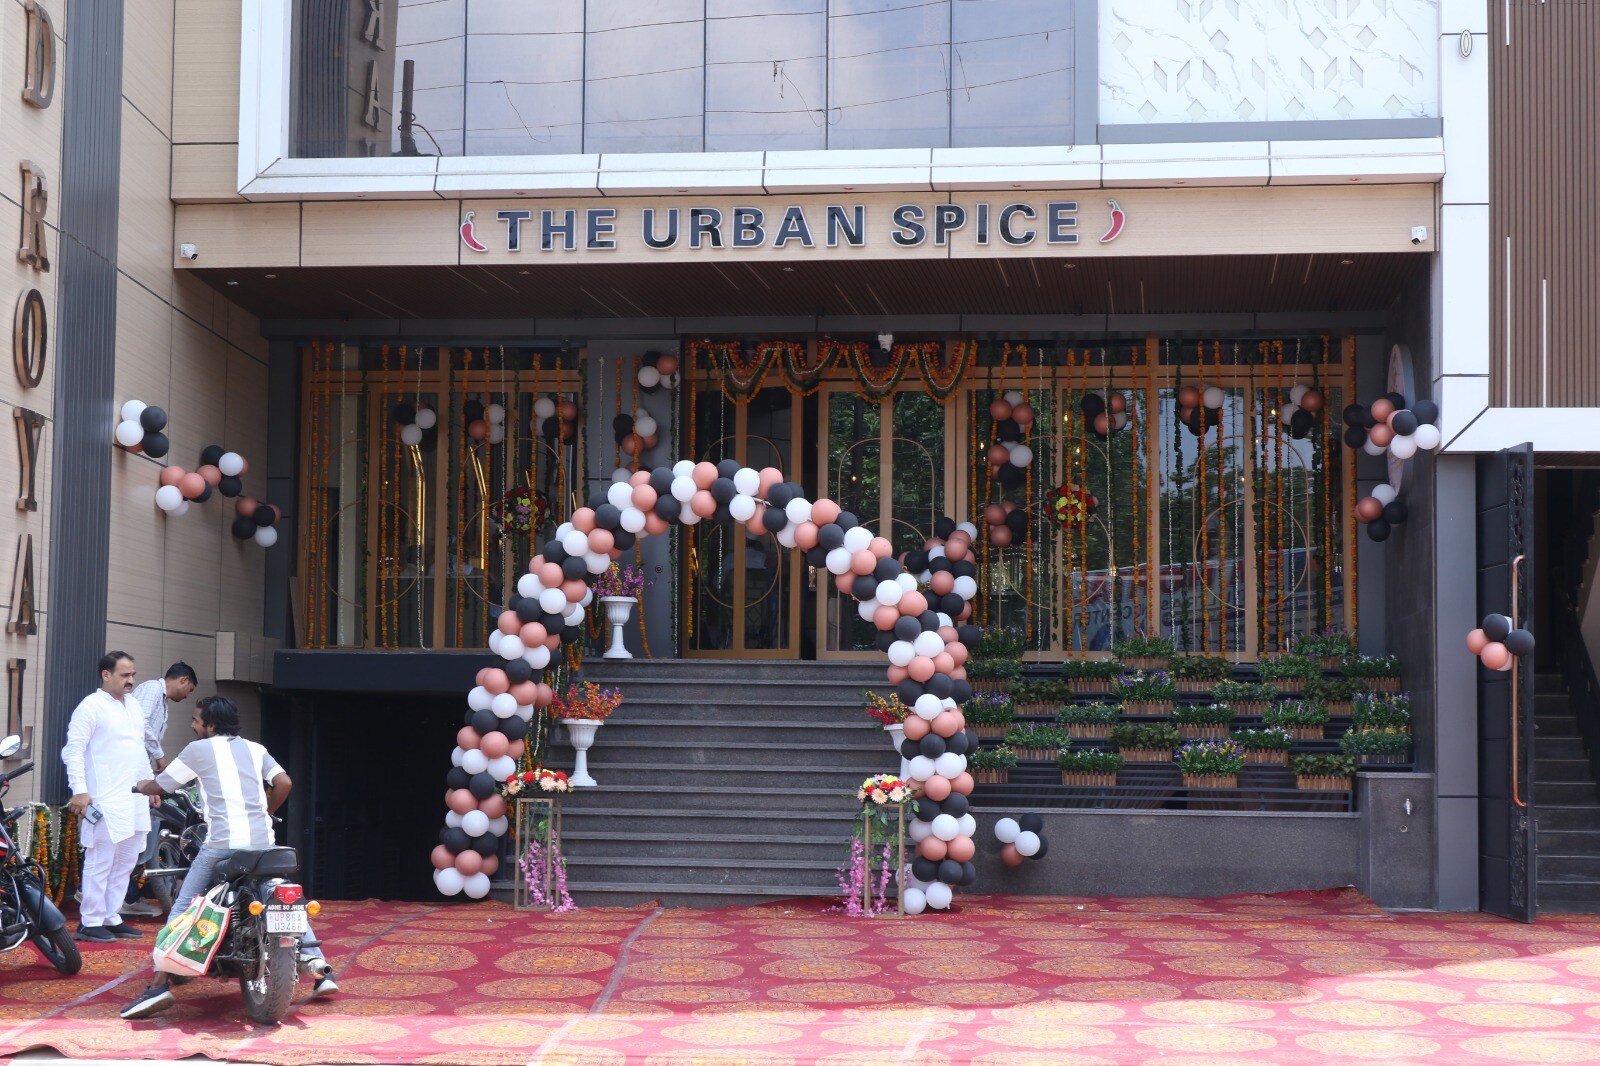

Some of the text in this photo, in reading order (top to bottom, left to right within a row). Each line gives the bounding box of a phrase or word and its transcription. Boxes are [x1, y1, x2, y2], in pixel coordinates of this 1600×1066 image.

[497, 201, 1079, 251] THE URBAN SPICE
[274, 912, 303, 922] UP86A
[274, 922, 303, 931] U3466
